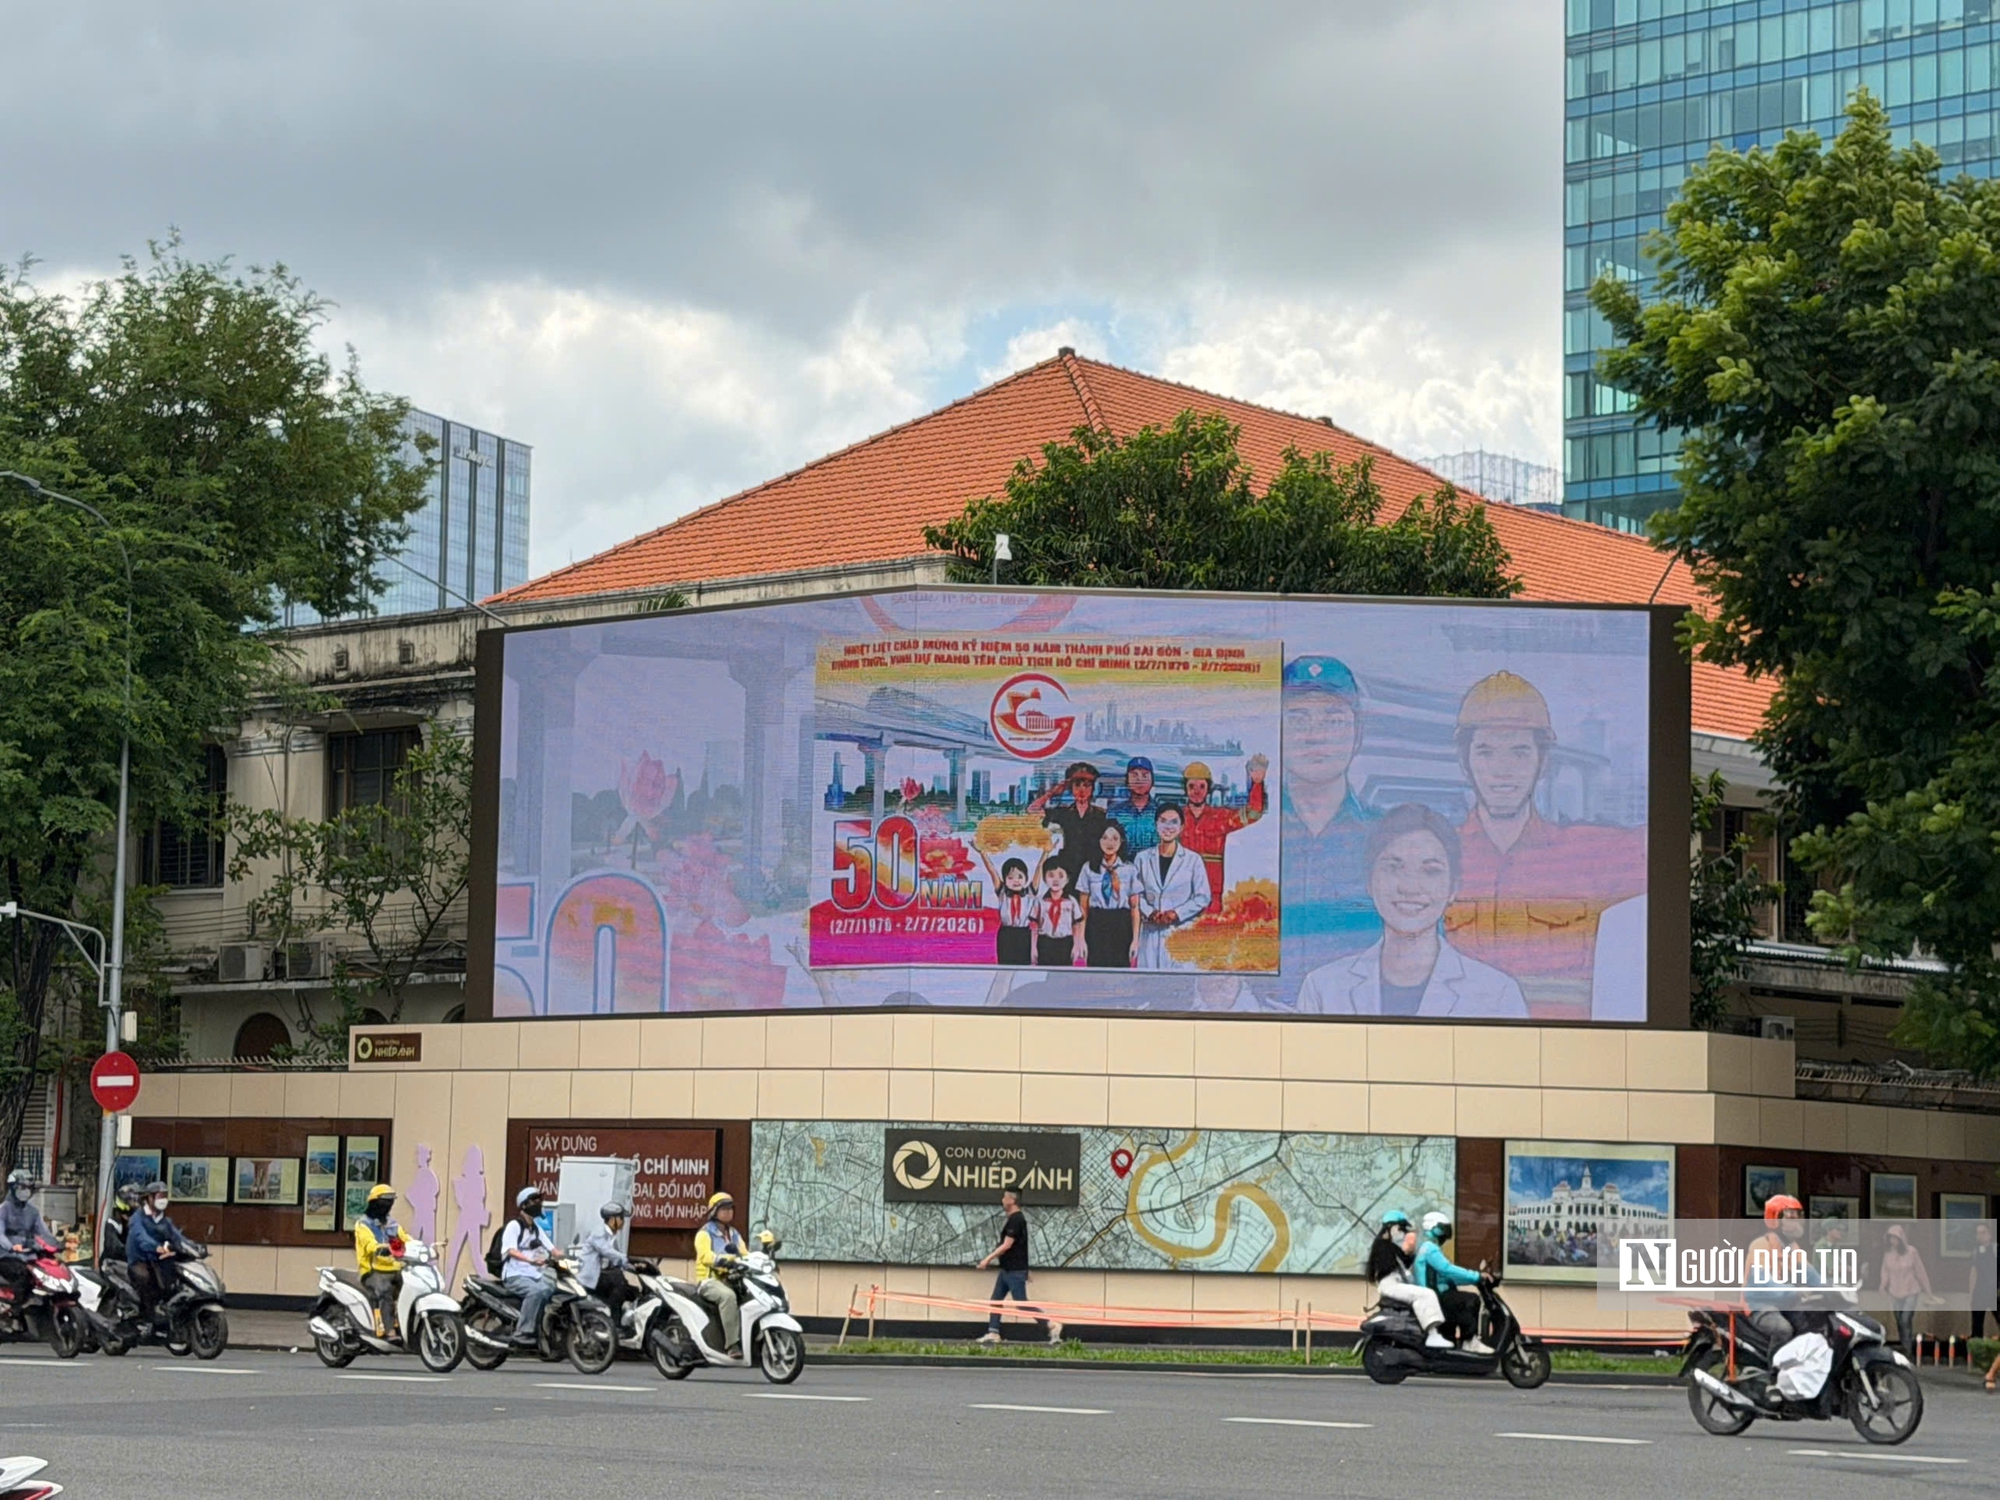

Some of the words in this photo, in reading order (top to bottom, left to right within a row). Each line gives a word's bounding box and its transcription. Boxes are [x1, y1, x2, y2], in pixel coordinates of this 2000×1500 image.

[832, 816, 918, 909] 50
[535, 1133, 559, 1151] XÂY
[561, 1135, 597, 1154] DỰNG
[945, 1147, 974, 1159] CON
[977, 1147, 1026, 1160] ĐƯỜNG
[535, 1154, 562, 1173] THÀ
[644, 1154, 669, 1175] CHÍ
[672, 1158, 709, 1175] MINH
[943, 1160, 1017, 1189] NHIẾP
[683, 1180, 706, 1199] MỚI
[655, 1202, 674, 1221] HỘI
